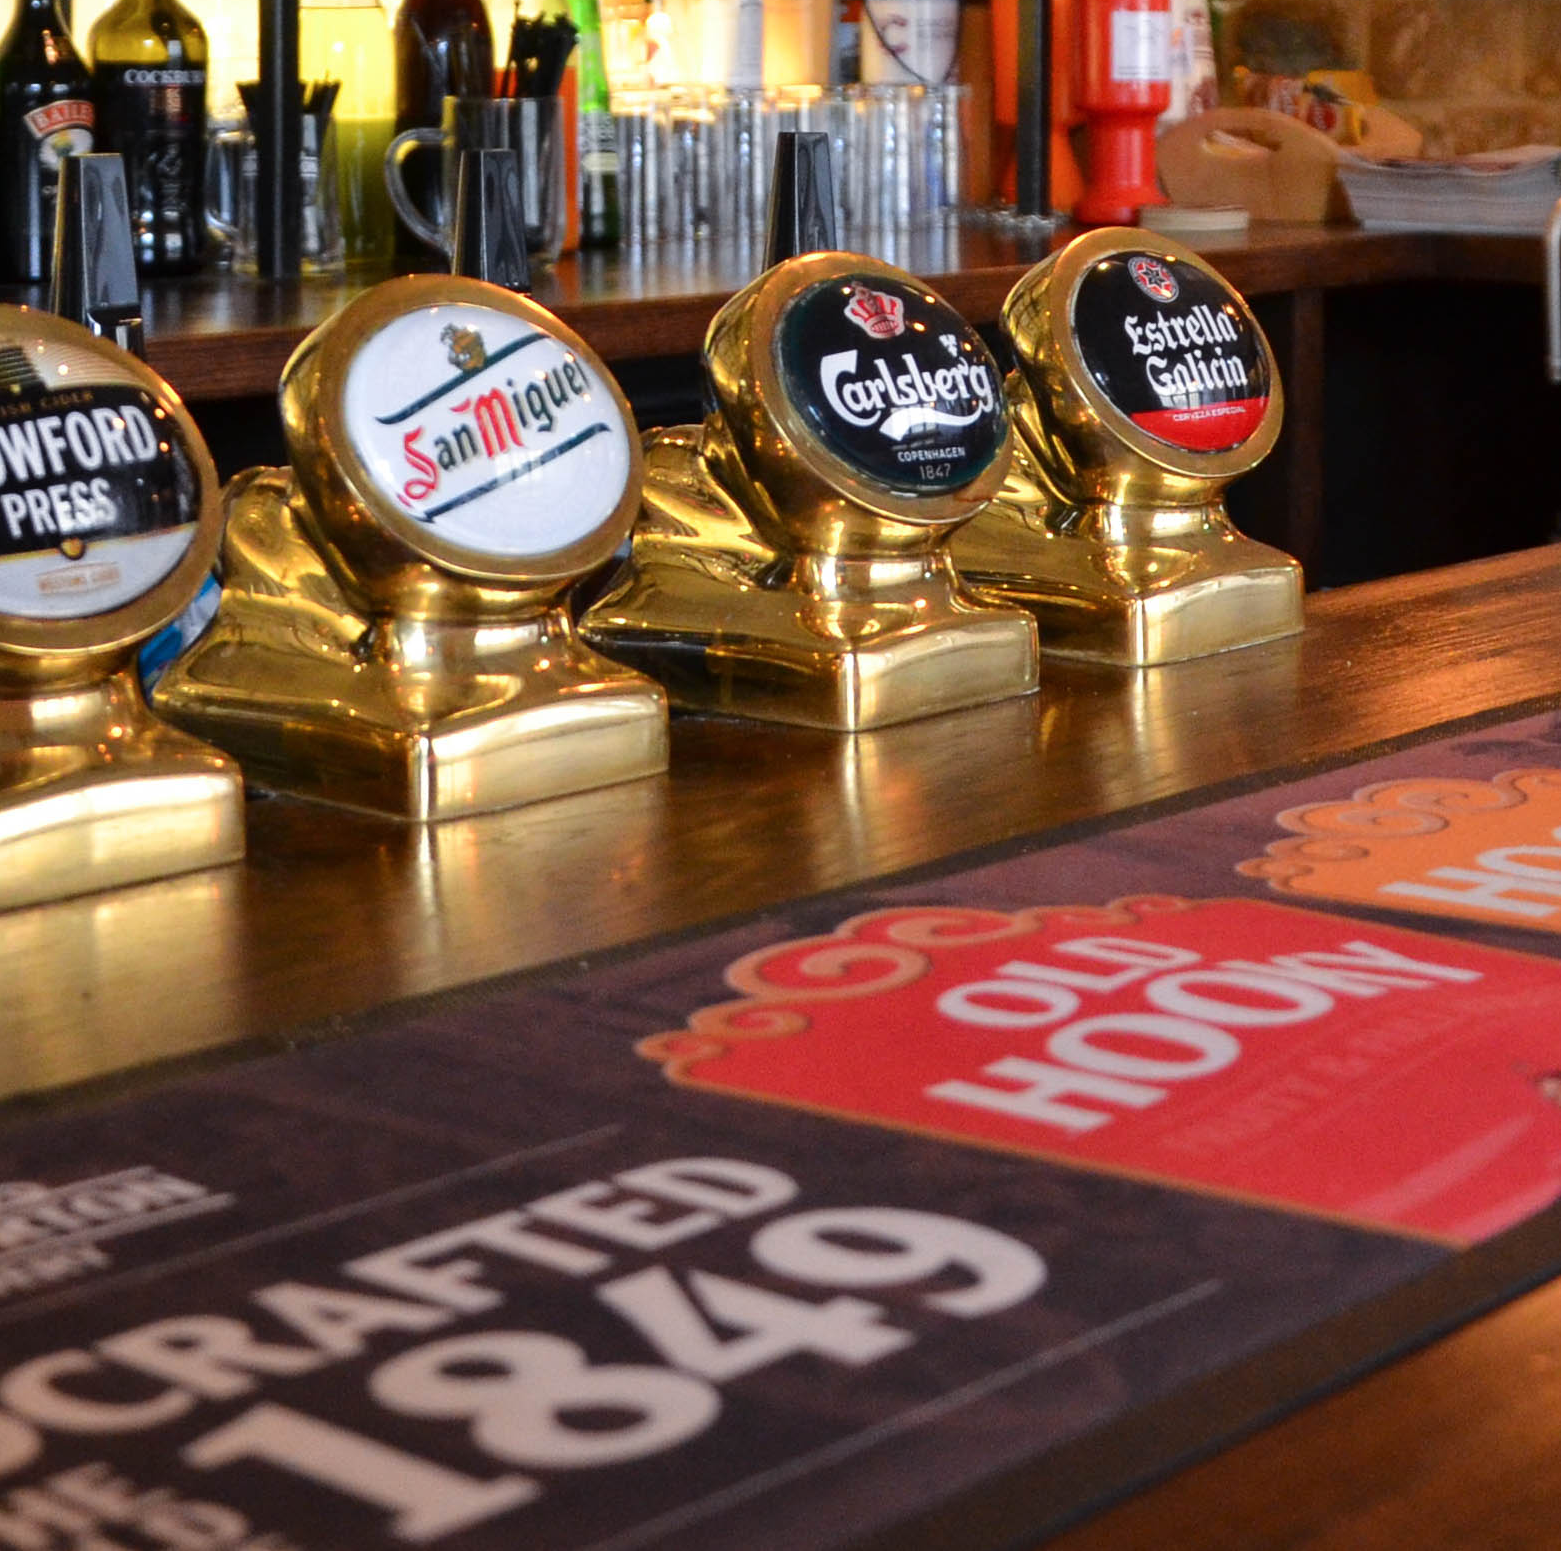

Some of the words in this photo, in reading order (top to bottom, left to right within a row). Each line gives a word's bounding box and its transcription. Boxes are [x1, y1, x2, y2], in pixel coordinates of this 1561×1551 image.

[1124, 304, 1238, 356] Estrella
[820, 348, 994, 442] Carlsberg
[1145, 346, 1249, 396] Galicia
[897, 447, 966, 463] COPENHAGEN
[919, 462, 951, 480] 1847
[0, 478, 119, 540] PRESS
[936, 933, 1203, 1029] OLD
[925, 938, 1485, 1134] HOOKY
[184, 1204, 1049, 1543] 1849
